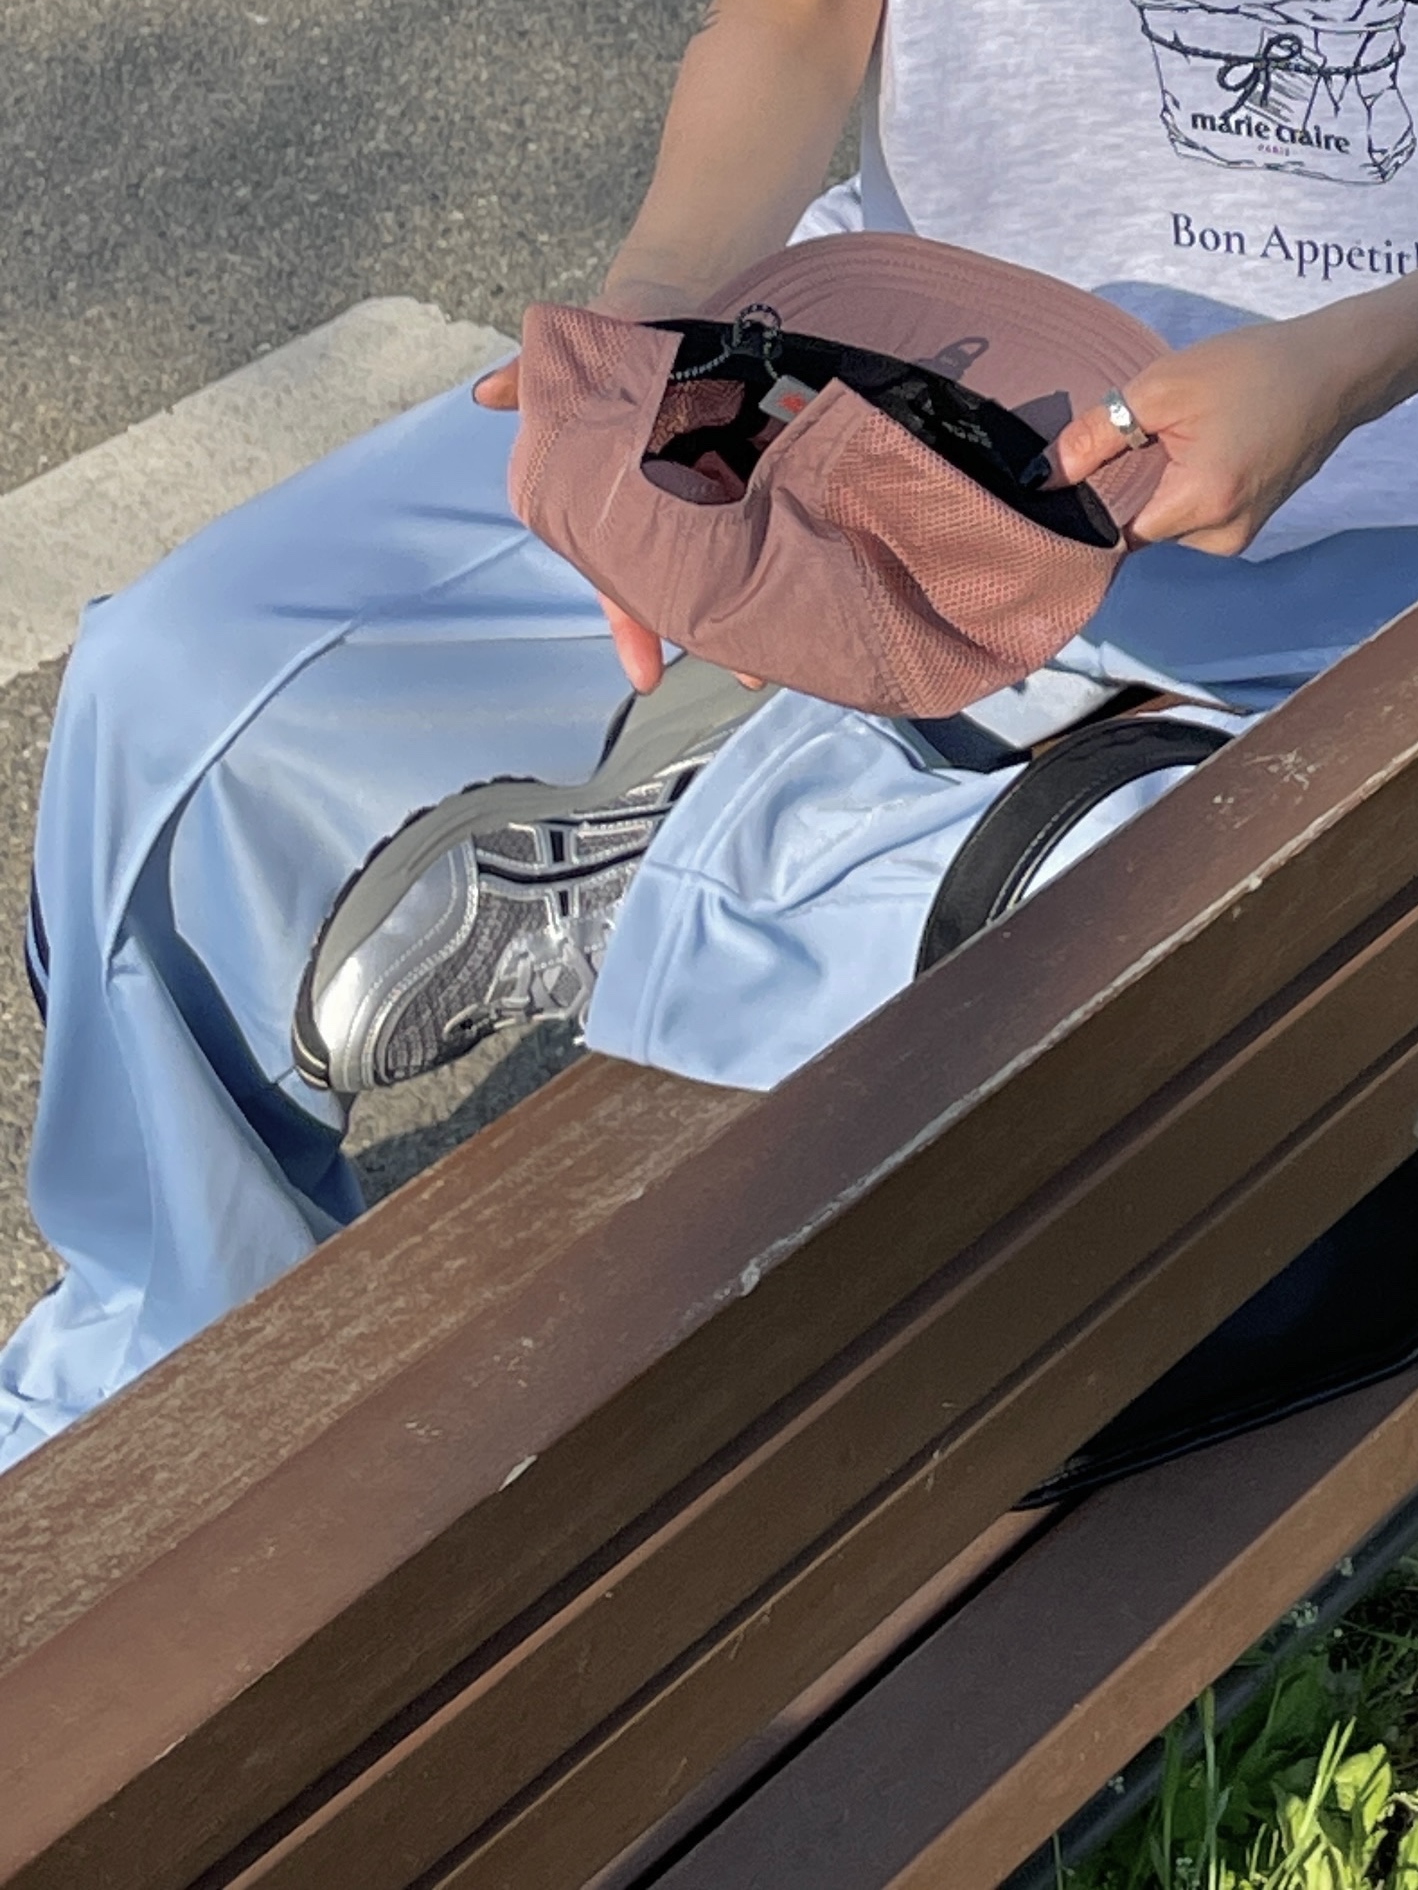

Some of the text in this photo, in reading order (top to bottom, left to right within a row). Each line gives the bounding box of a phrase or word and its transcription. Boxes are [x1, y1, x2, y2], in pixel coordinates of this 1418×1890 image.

[1191, 112, 1351, 155] marie claire
[1170, 211, 1246, 255] Bon
